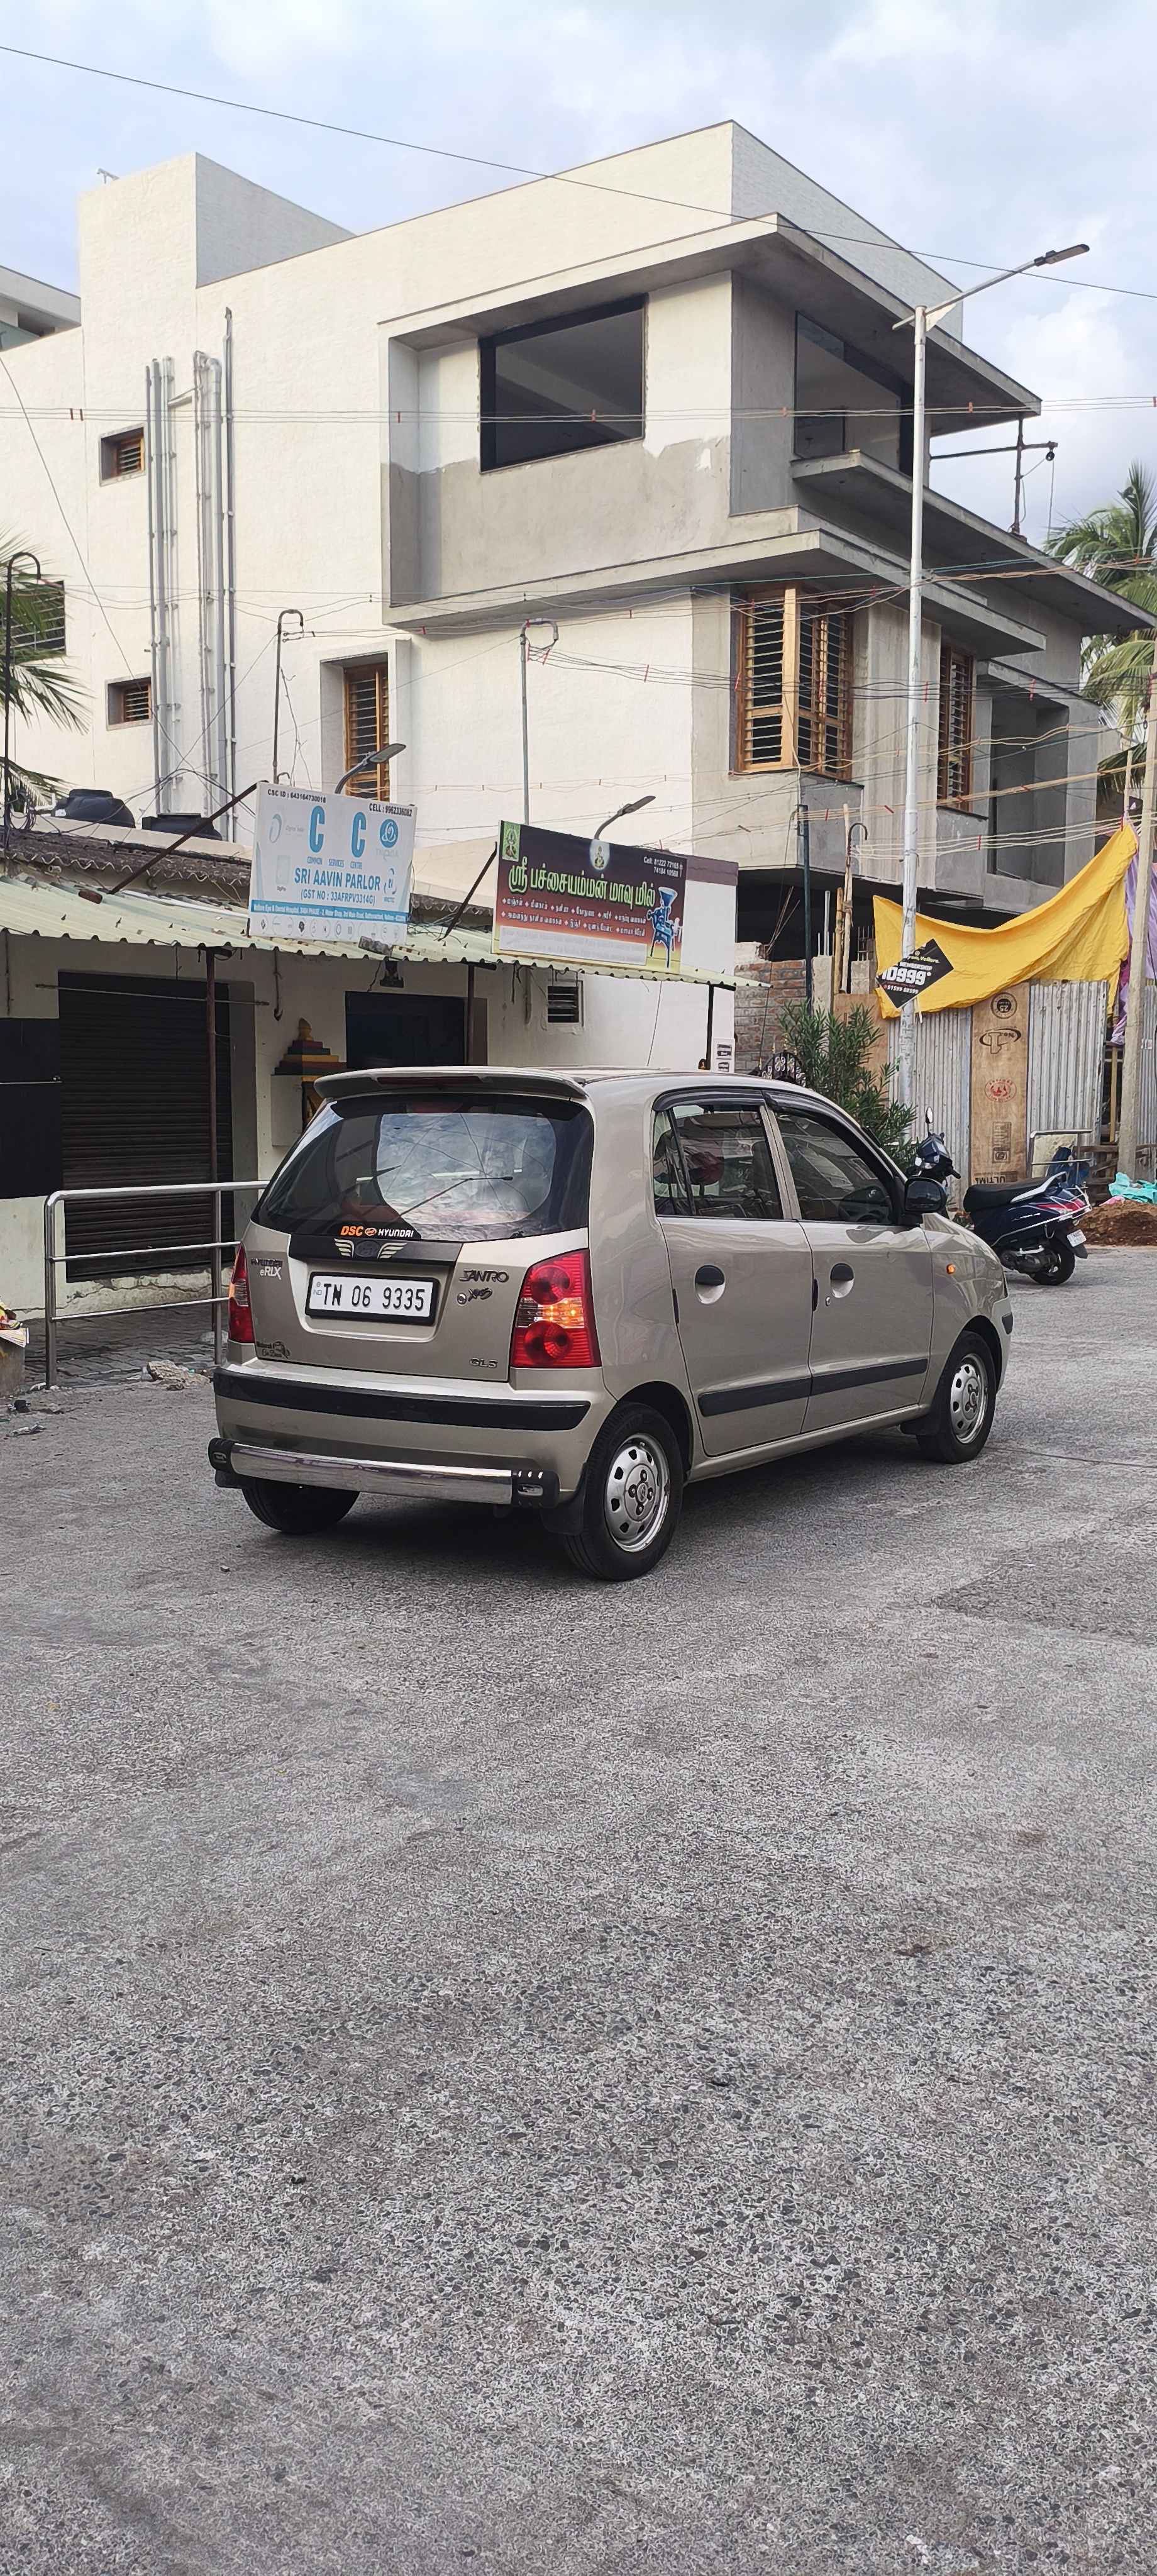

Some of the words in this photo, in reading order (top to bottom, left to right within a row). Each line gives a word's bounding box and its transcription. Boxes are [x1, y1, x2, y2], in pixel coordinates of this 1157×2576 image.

[267, 789, 279, 797] CSC
[369, 803, 381, 813] CELL
[294, 867, 311, 884] SRI
[313, 869, 343, 887] AAVIN
[345, 873, 380, 891] PARLOR
[509, 857, 528, 893] ஸ்ரீ
[530, 863, 608, 900] பச்சையம்மன்
[609, 882, 633, 909] மாவு
[635, 881, 655, 908] மில்
[301, 889, 315, 901] (GST
[317, 891, 326, 900] NO
[340, 1226, 364, 1236] DSC
[378, 1228, 414, 1238] HYUNDAI
[260, 1266, 282, 1280] eRLX
[459, 1269, 509, 1283] SANTRO
[323, 1283, 342, 1306] TN
[352, 1285, 373, 1307] 06
[382, 1287, 426, 1311] 9335
[470, 1358, 499, 1368] GLS
